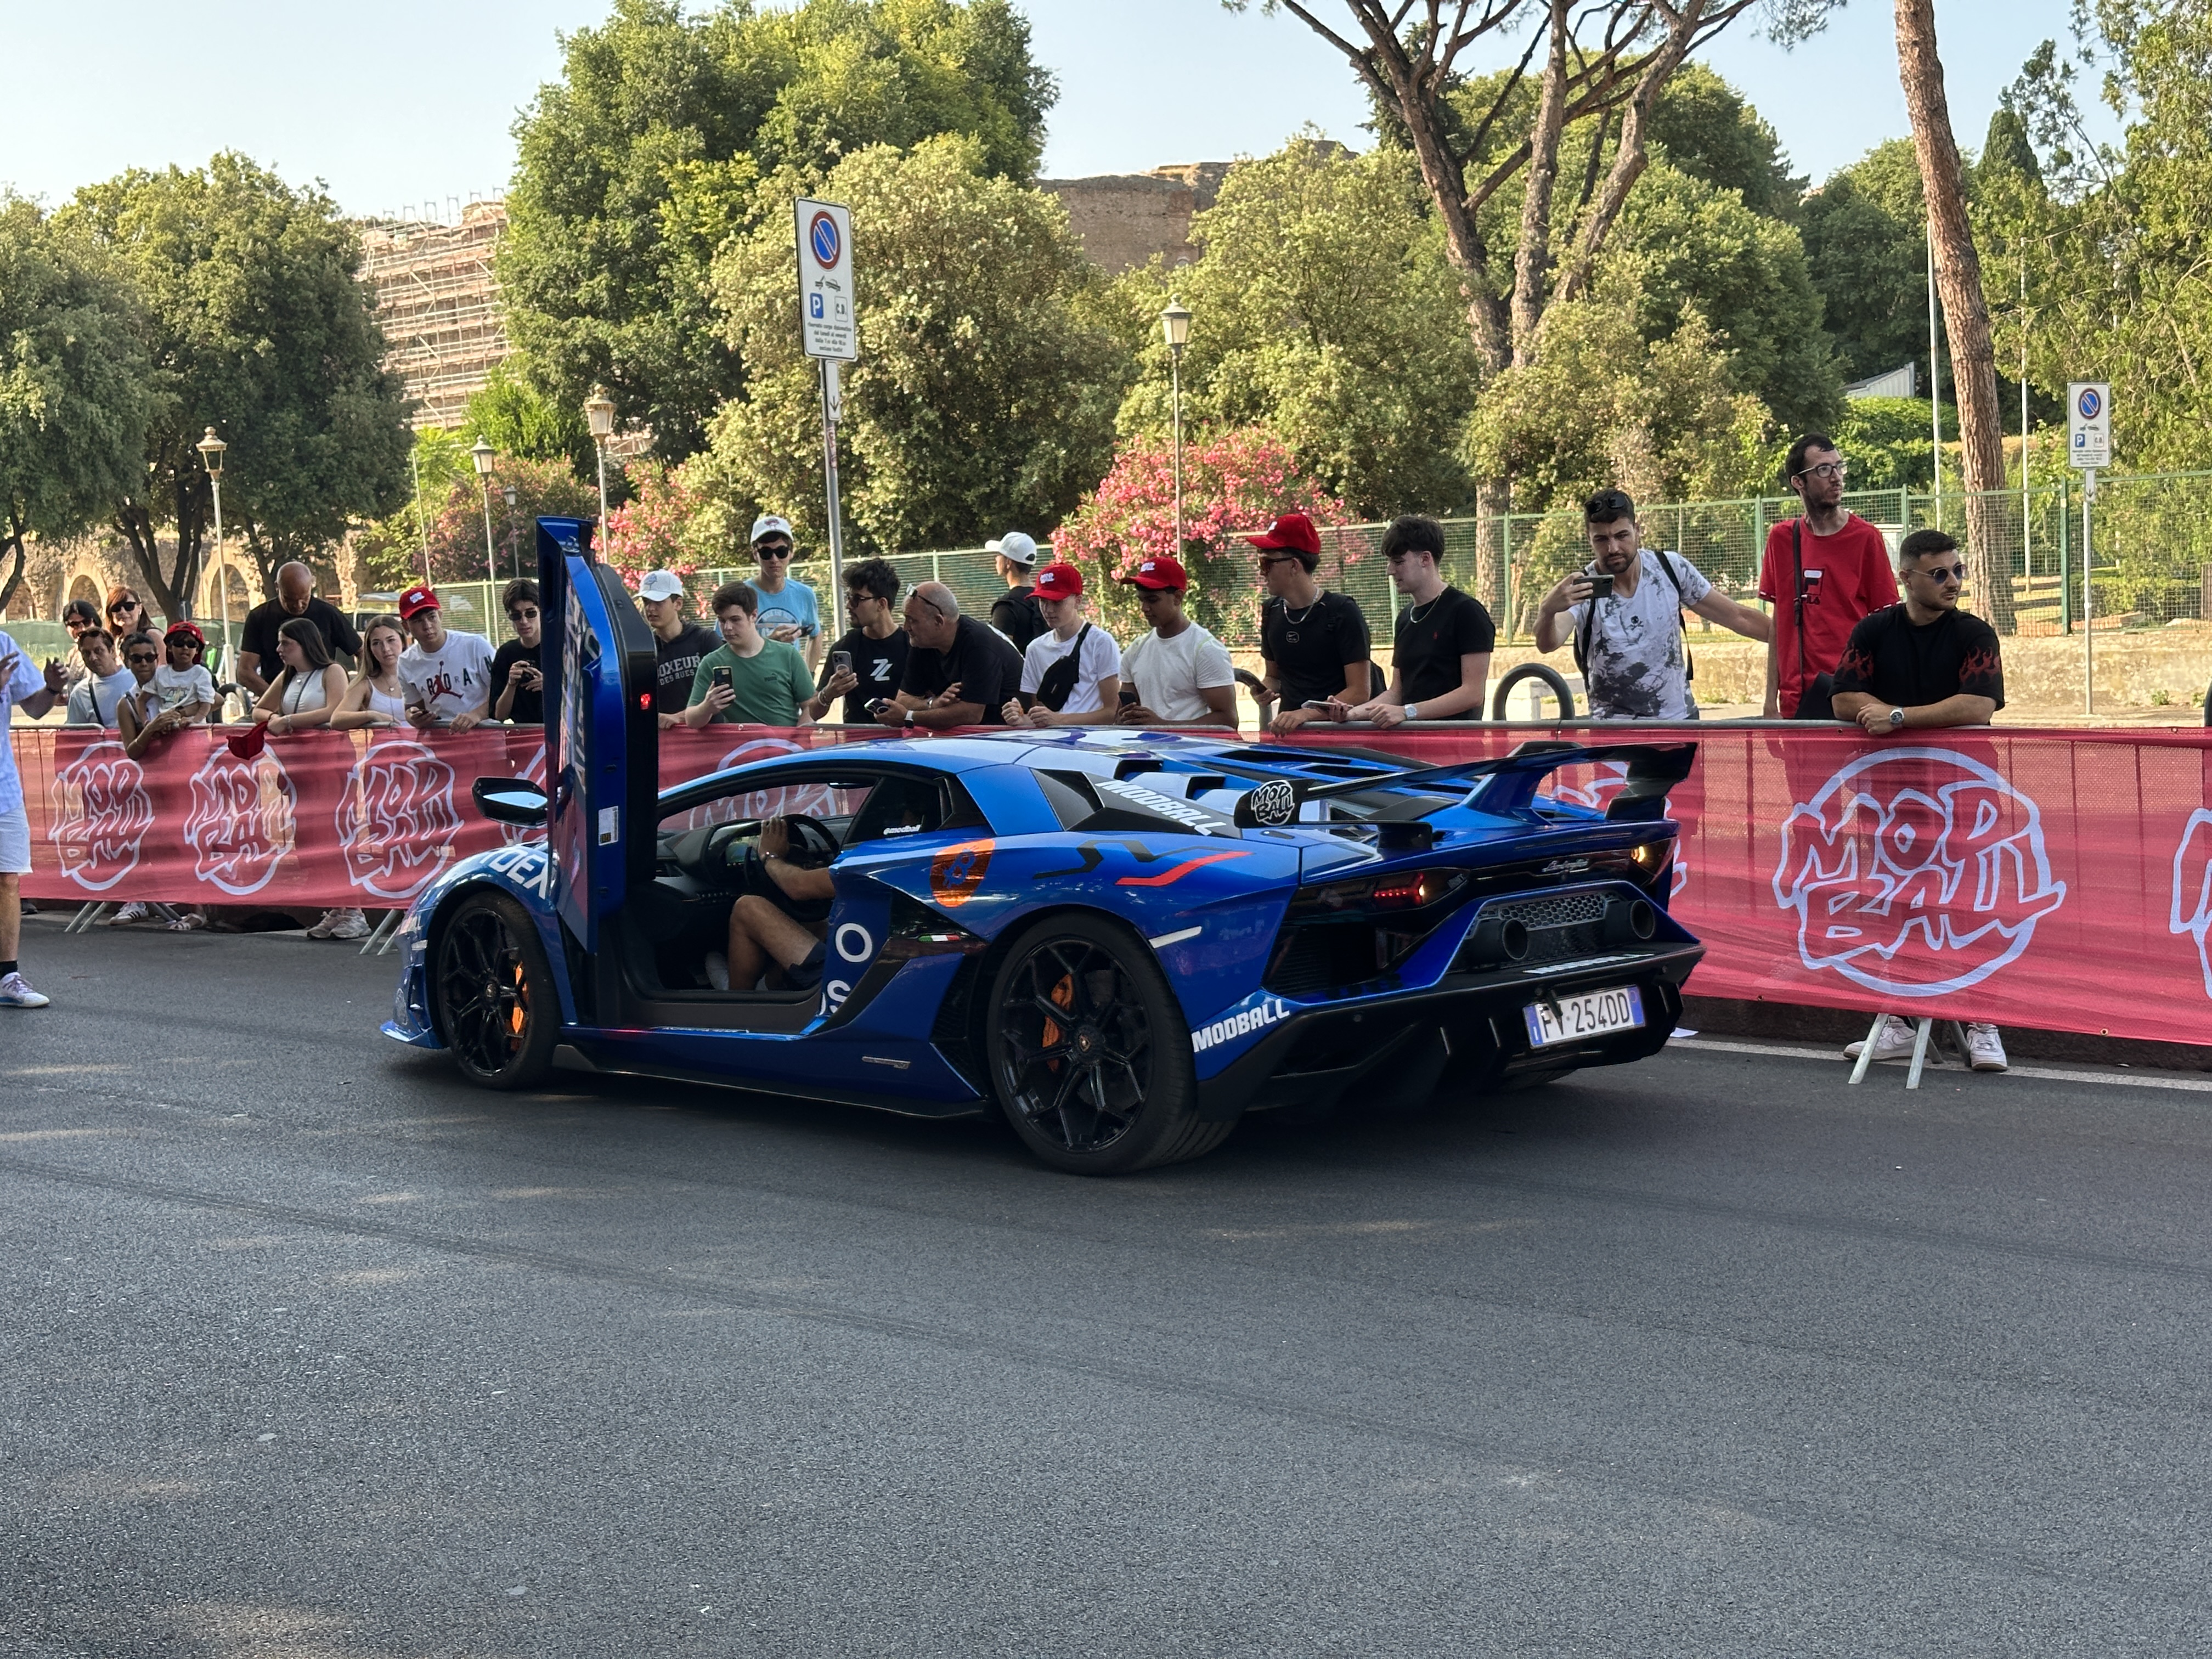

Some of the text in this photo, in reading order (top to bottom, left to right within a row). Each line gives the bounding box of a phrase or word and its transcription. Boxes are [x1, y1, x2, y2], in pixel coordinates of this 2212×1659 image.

[812, 296, 821, 315] P
[2076, 435, 2084, 445] P
[658, 655, 701, 677] OXEUR
[660, 669, 695, 686] DES RUES
[1095, 780, 1226, 836] MODBALL
[1571, 992, 1630, 1033] 254DD
[1191, 998, 1290, 1053] MODBALL
